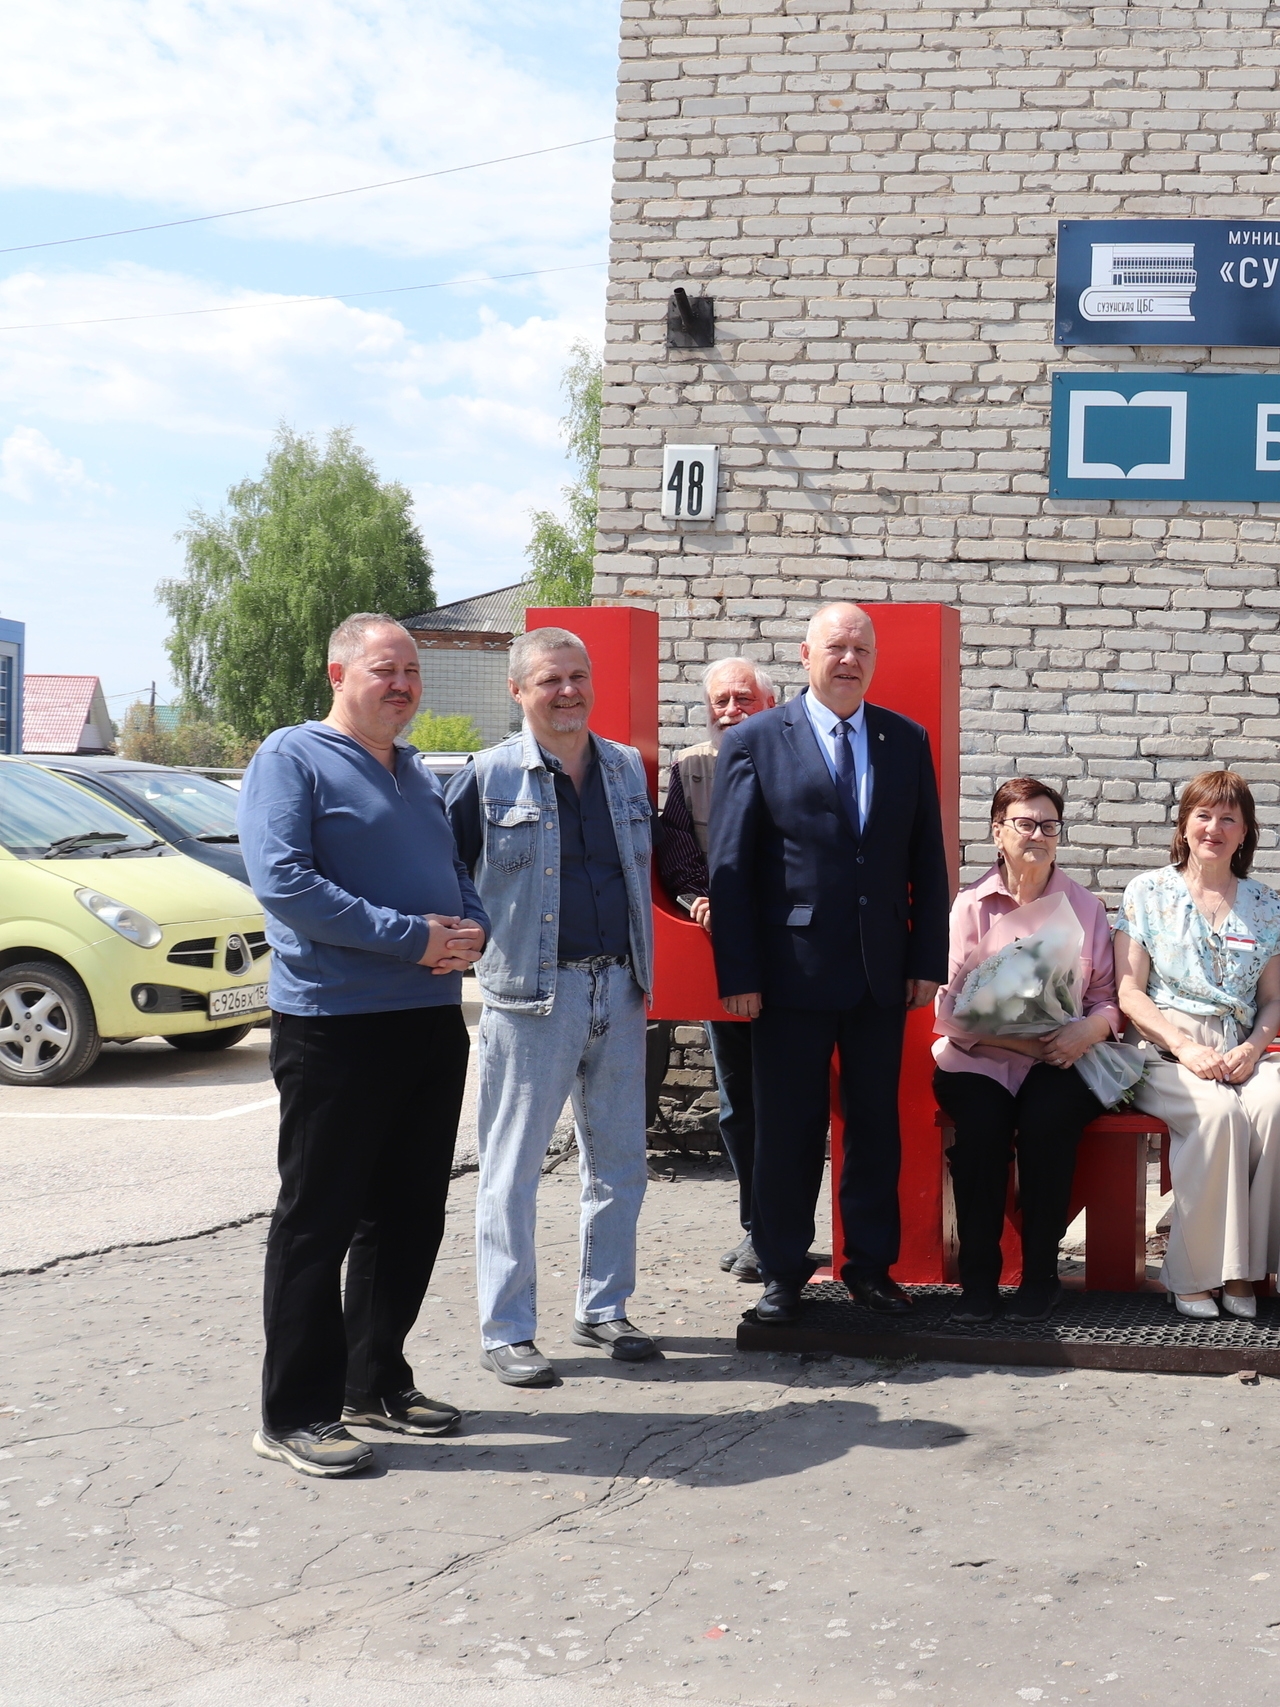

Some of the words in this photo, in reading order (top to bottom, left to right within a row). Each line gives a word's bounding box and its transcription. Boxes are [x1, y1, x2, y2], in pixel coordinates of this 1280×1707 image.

[1097, 301, 1134, 313] СУЗУНСКАЯ
[1136, 299, 1154, 314] ЦБС
[667, 460, 704, 517] 48
